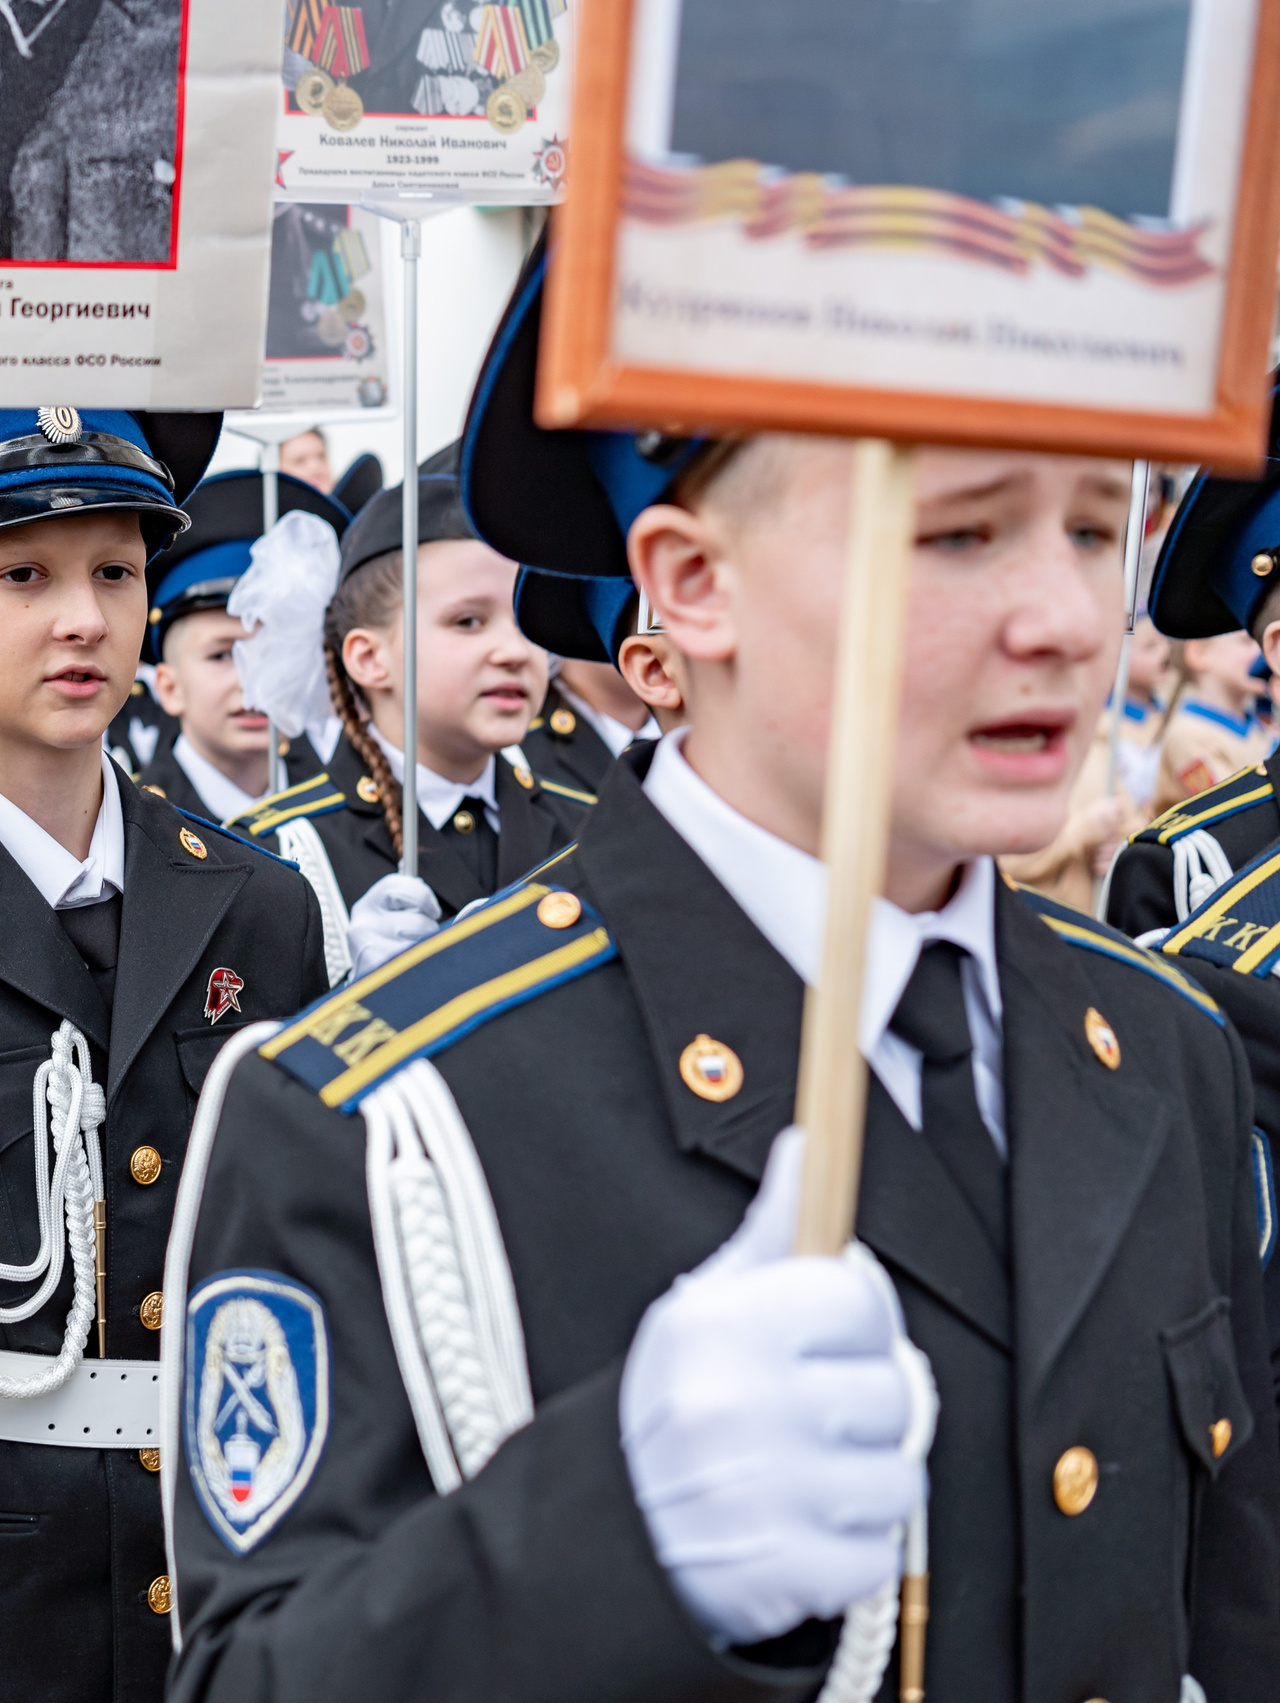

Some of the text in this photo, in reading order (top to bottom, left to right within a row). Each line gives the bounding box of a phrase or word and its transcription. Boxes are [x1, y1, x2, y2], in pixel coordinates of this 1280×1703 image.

[319, 134, 507, 149] Ковалев Николай Иванович
[10, 297, 150, 323] Георгиевич
[22, 356, 70, 366] класса
[75, 354, 106, 366] ФСО
[111, 354, 162, 367] России
